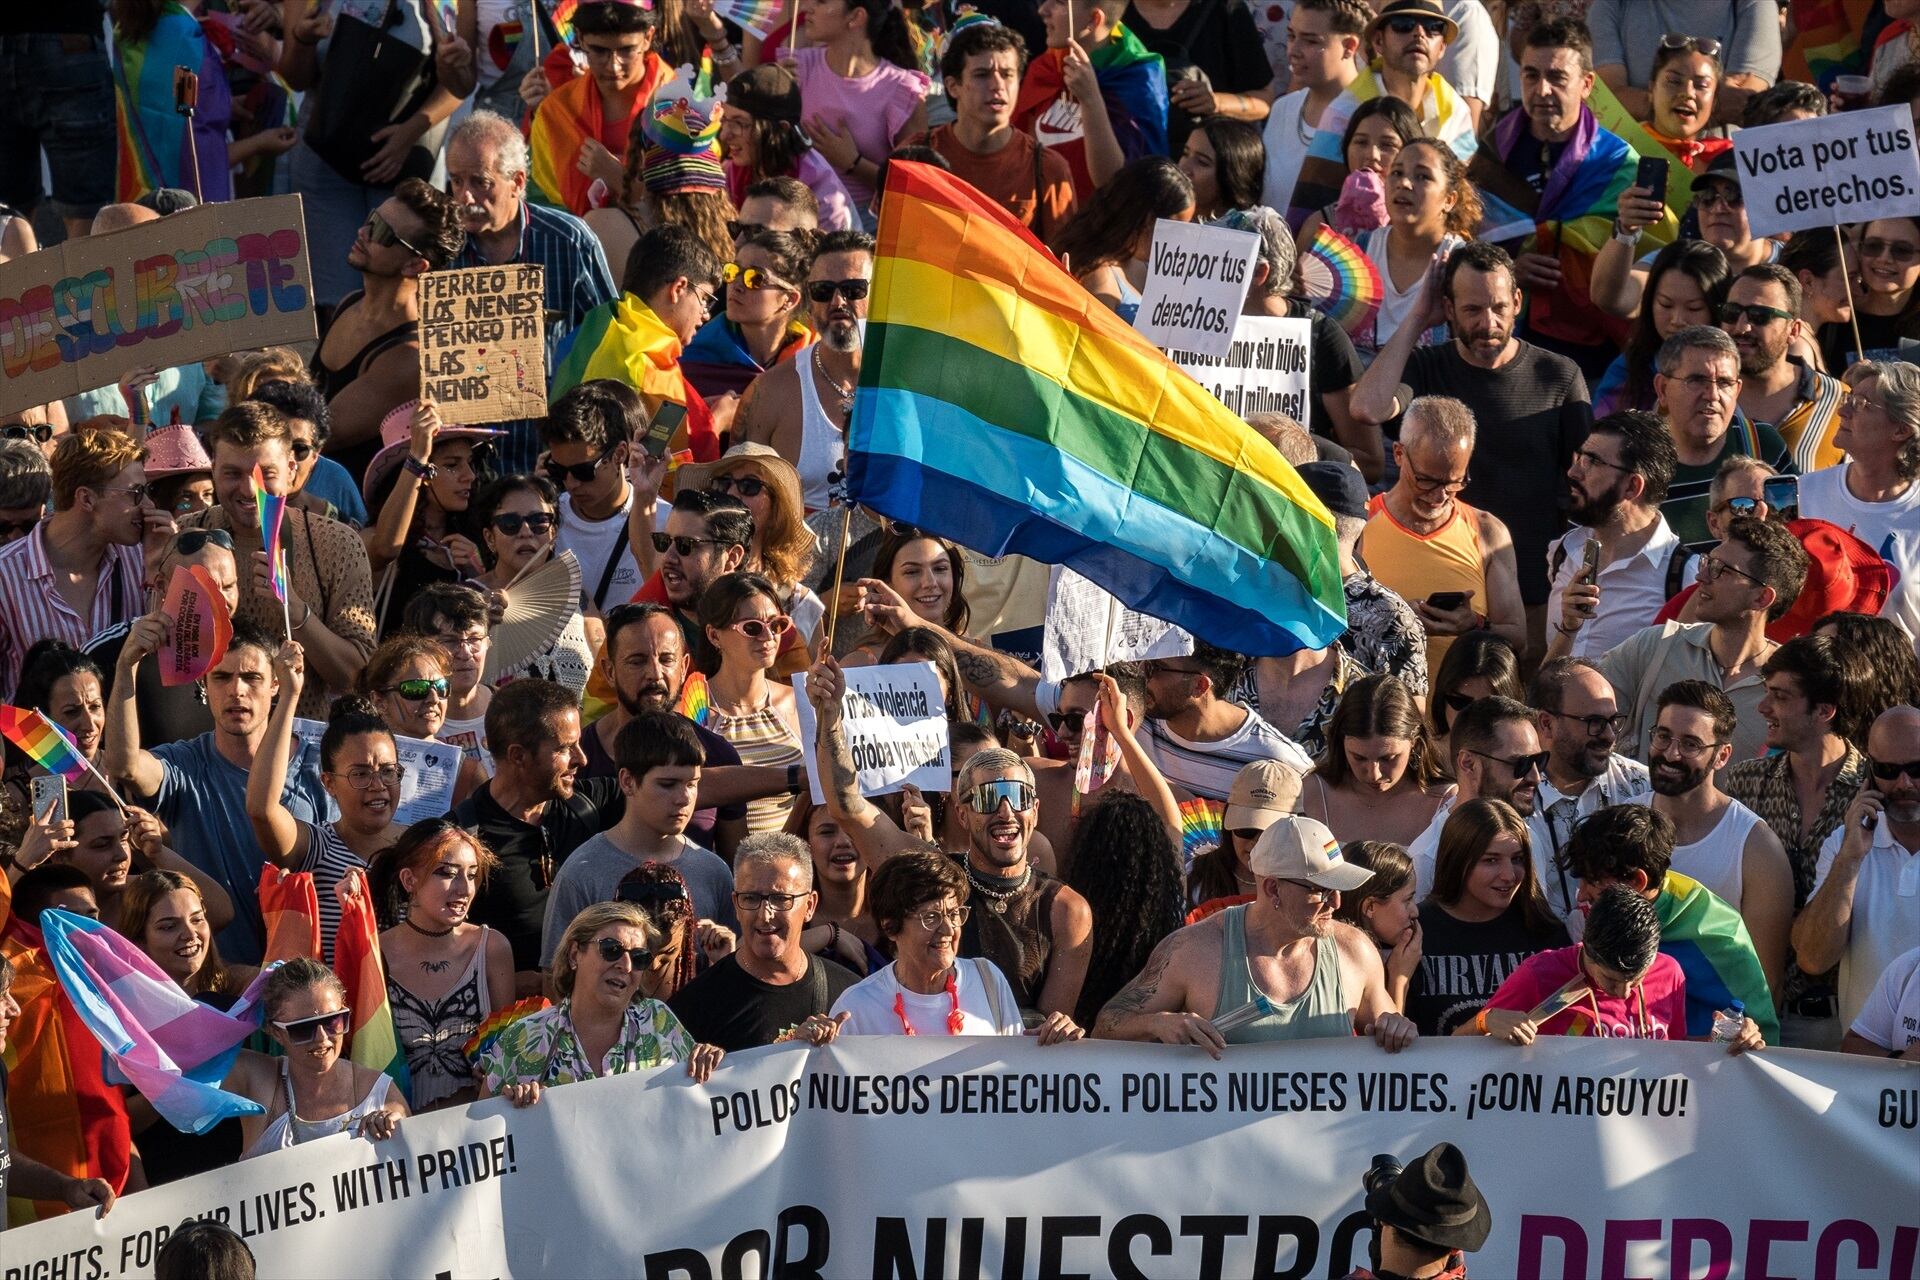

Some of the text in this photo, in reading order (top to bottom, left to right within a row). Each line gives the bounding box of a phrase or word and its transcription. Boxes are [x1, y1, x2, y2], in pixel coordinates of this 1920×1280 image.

[1740, 127, 1911, 177] Vota por tus
[1775, 174, 1914, 215] derechos.
[1154, 241, 1247, 286] Vota por tus
[424, 267, 541, 299] PERREO PA
[423, 291, 540, 324] LOS NENES
[1152, 294, 1229, 334] derechos.
[423, 315, 537, 350] PERREO PA
[424, 349, 465, 377] LAS
[1256, 337, 1275, 371] sin
[1275, 338, 1307, 375] hijos
[425, 374, 490, 404] NENAS
[1224, 384, 1244, 418] mil
[1244, 386, 1306, 422] millones!
[873, 682, 929, 718] violencia
[893, 740, 905, 775] y
[711, 1072, 1688, 1136] POLOS NUESOS DERECHOS. POLES NUESES VIDES. ¡CON ARGUYU!
[120, 1225, 170, 1274] FOR
[240, 1181, 326, 1239] LIVES.
[332, 1157, 411, 1214] WITH
[418, 1134, 517, 1195] PRIDE!
